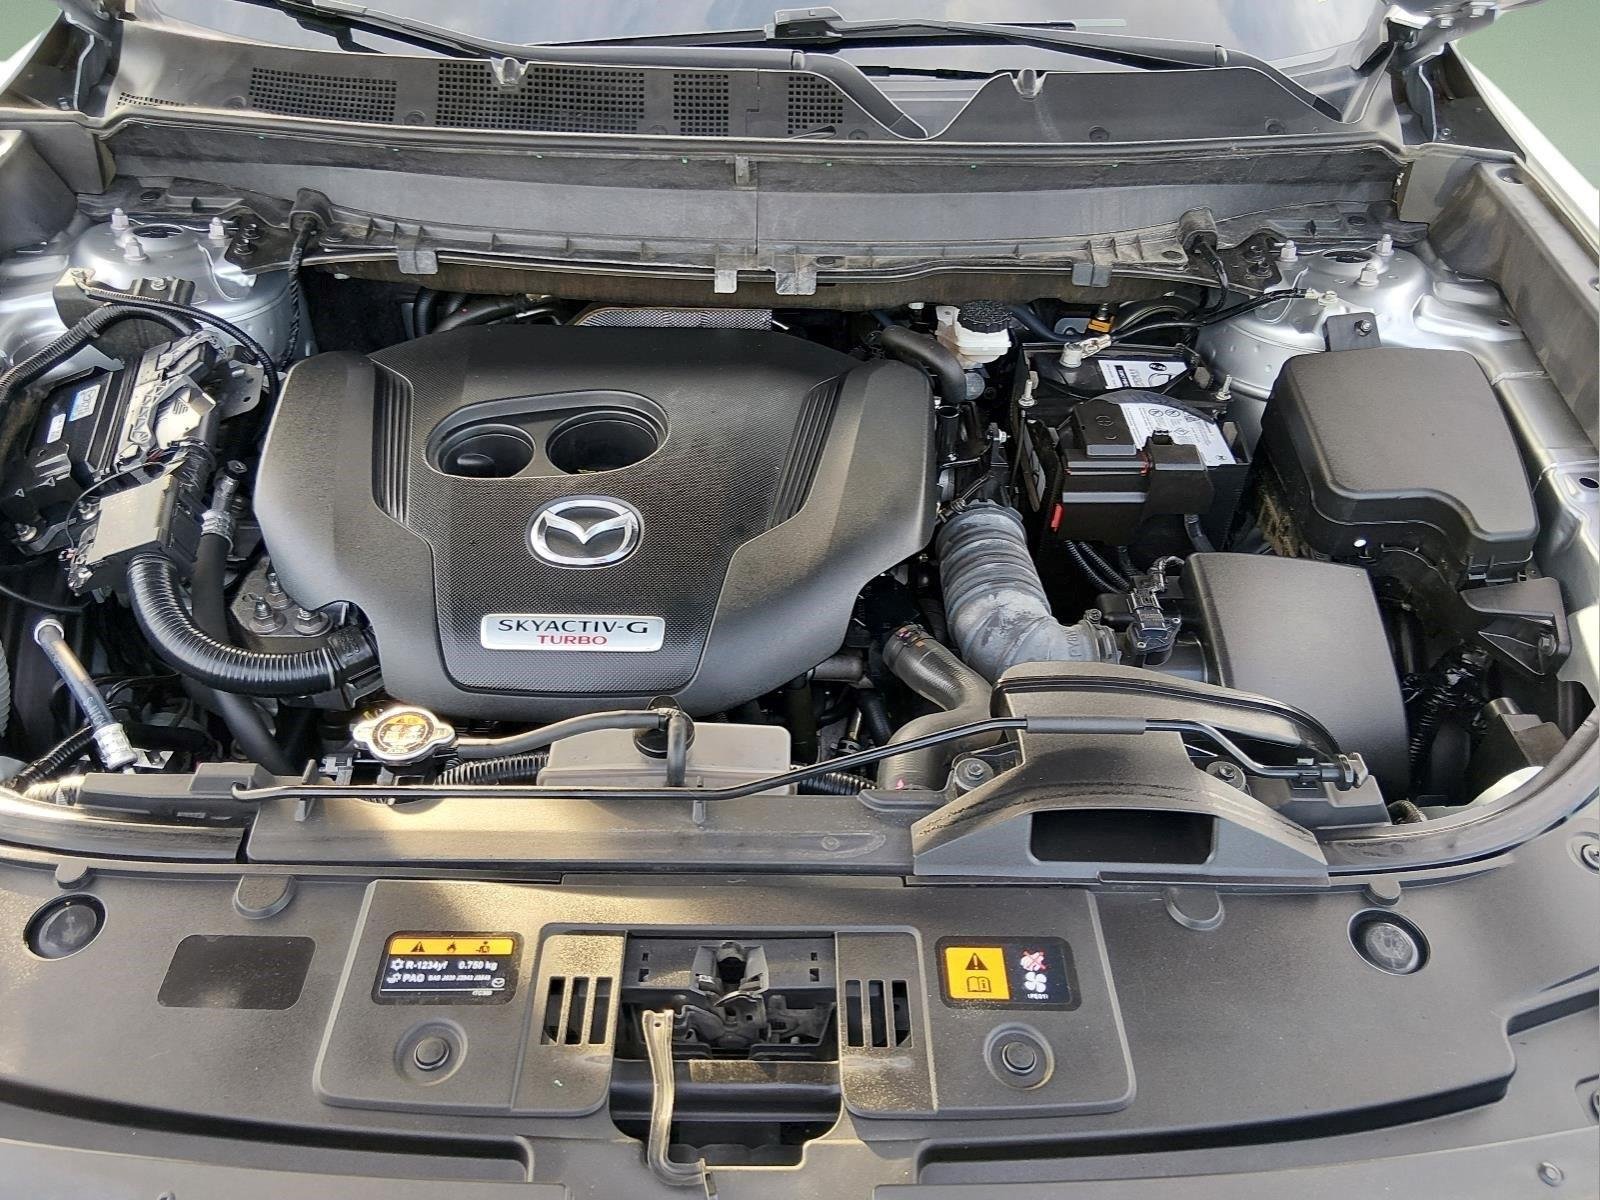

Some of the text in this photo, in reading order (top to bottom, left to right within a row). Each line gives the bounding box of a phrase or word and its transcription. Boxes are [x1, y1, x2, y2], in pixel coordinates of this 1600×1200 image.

[498, 619, 648, 633] SKYACTIV-G
[537, 635, 607, 645] TURBO
[405, 960, 448, 971] R-1234yf
[485, 960, 498, 971] kg
